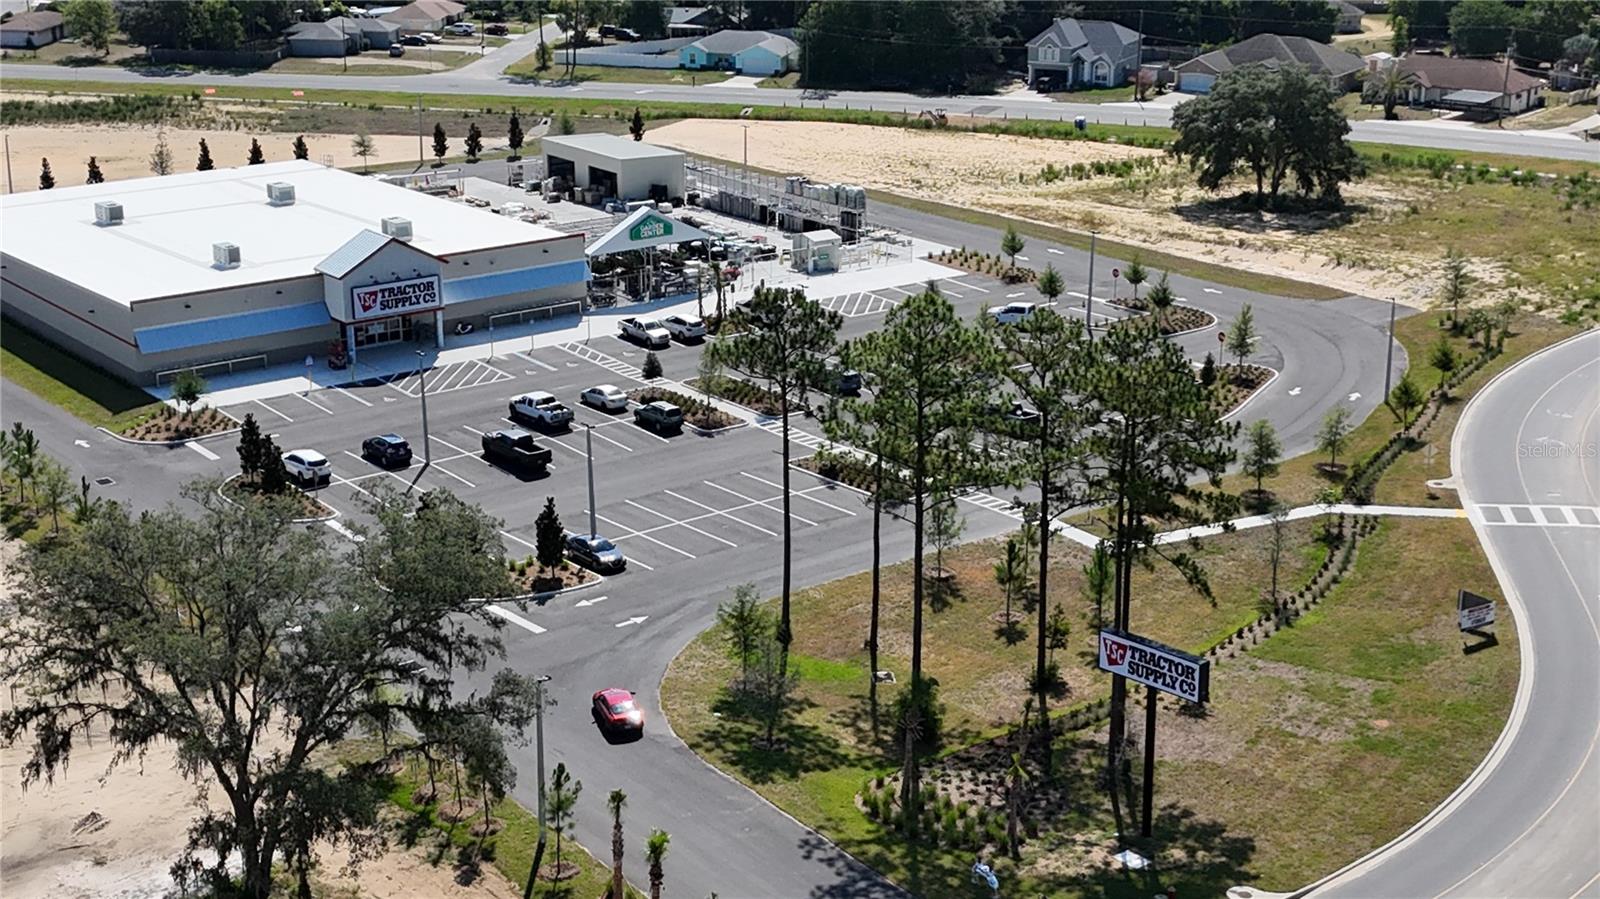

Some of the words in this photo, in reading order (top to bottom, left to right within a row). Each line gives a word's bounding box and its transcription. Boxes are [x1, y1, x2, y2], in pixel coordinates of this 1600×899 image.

[359, 292, 377, 307] TSC
[379, 281, 435, 299] TRACTOR
[380, 294, 422, 311] SUPPLY
[1105, 639, 1124, 665] TSC
[1128, 645, 1197, 682] TRACTOR
[1128, 660, 1179, 693] SUPPLY
